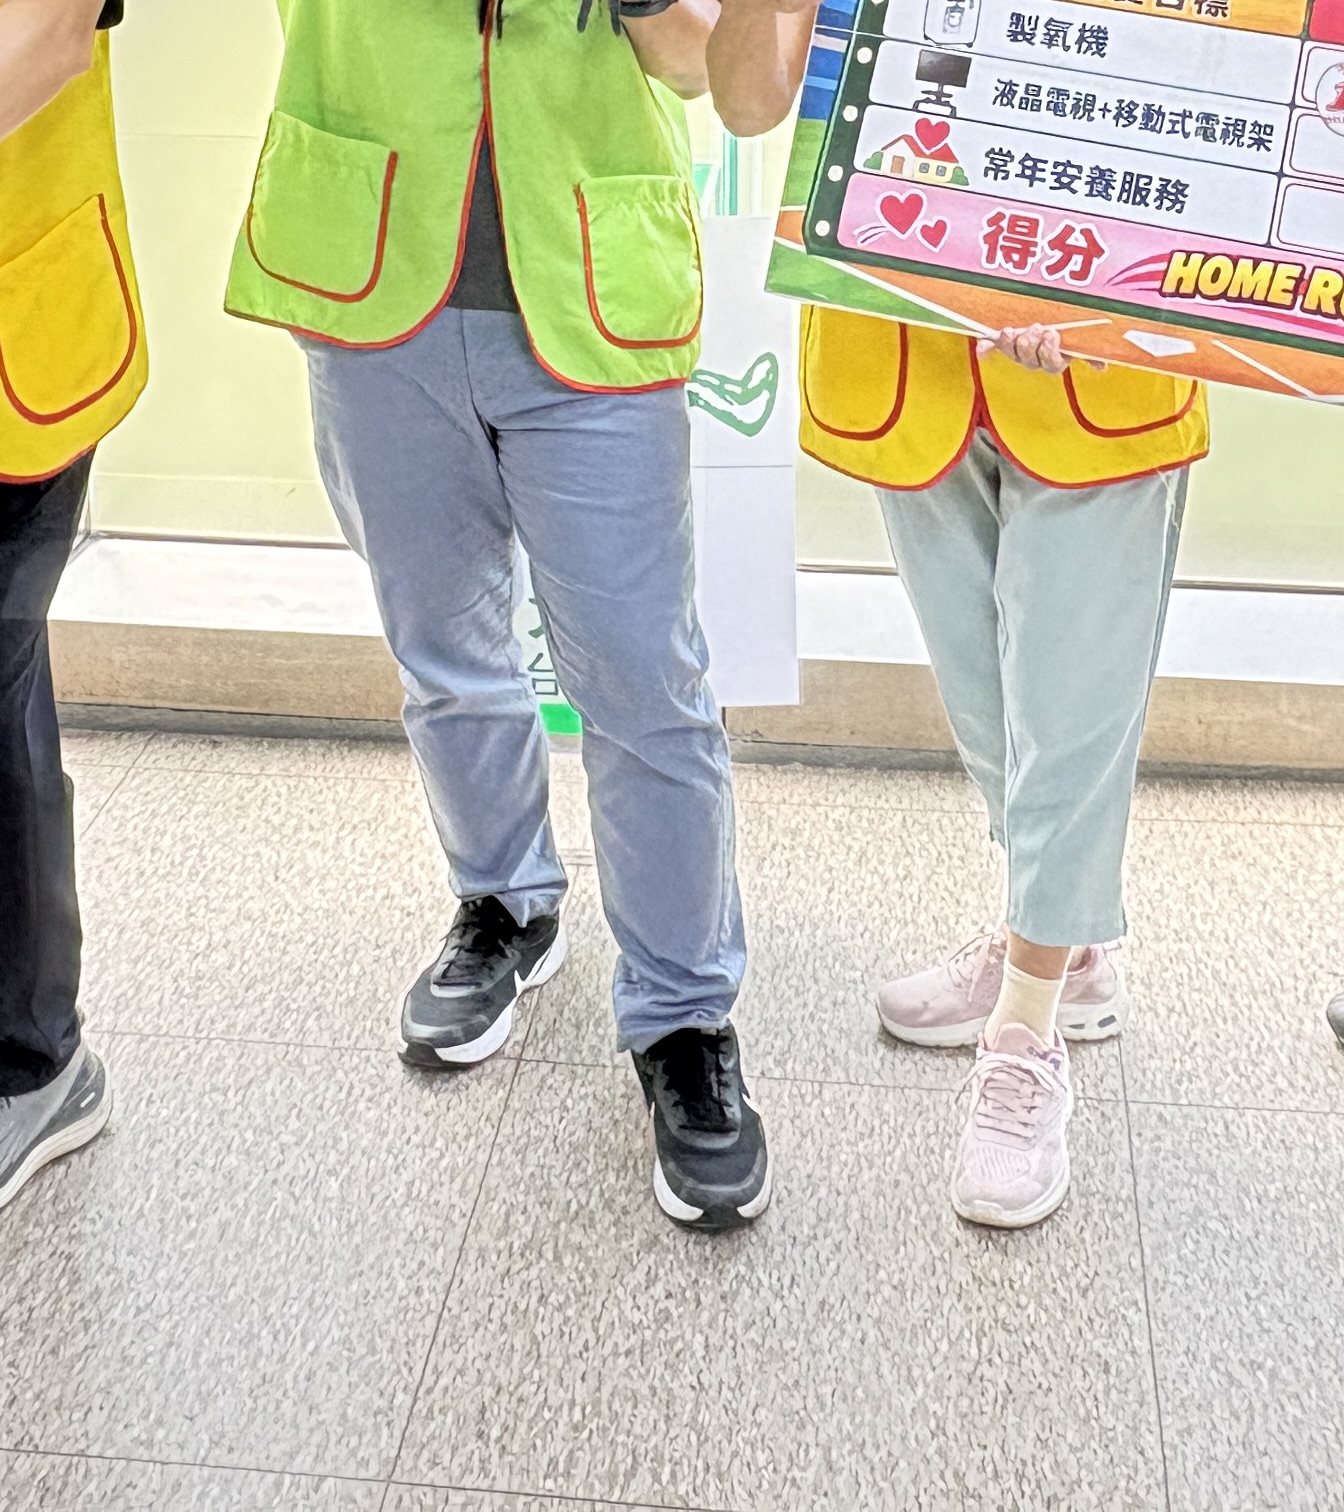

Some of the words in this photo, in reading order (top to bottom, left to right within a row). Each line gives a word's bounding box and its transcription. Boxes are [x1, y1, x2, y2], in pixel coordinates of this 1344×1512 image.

[1005, 11, 1110, 59] 製氧機
[991, 77, 1276, 153] 液晶電視+移動式電視架
[982, 146, 1191, 215] 常年安養服務
[982, 210, 1106, 281] 得分
[1160, 249, 1305, 310] HOME
